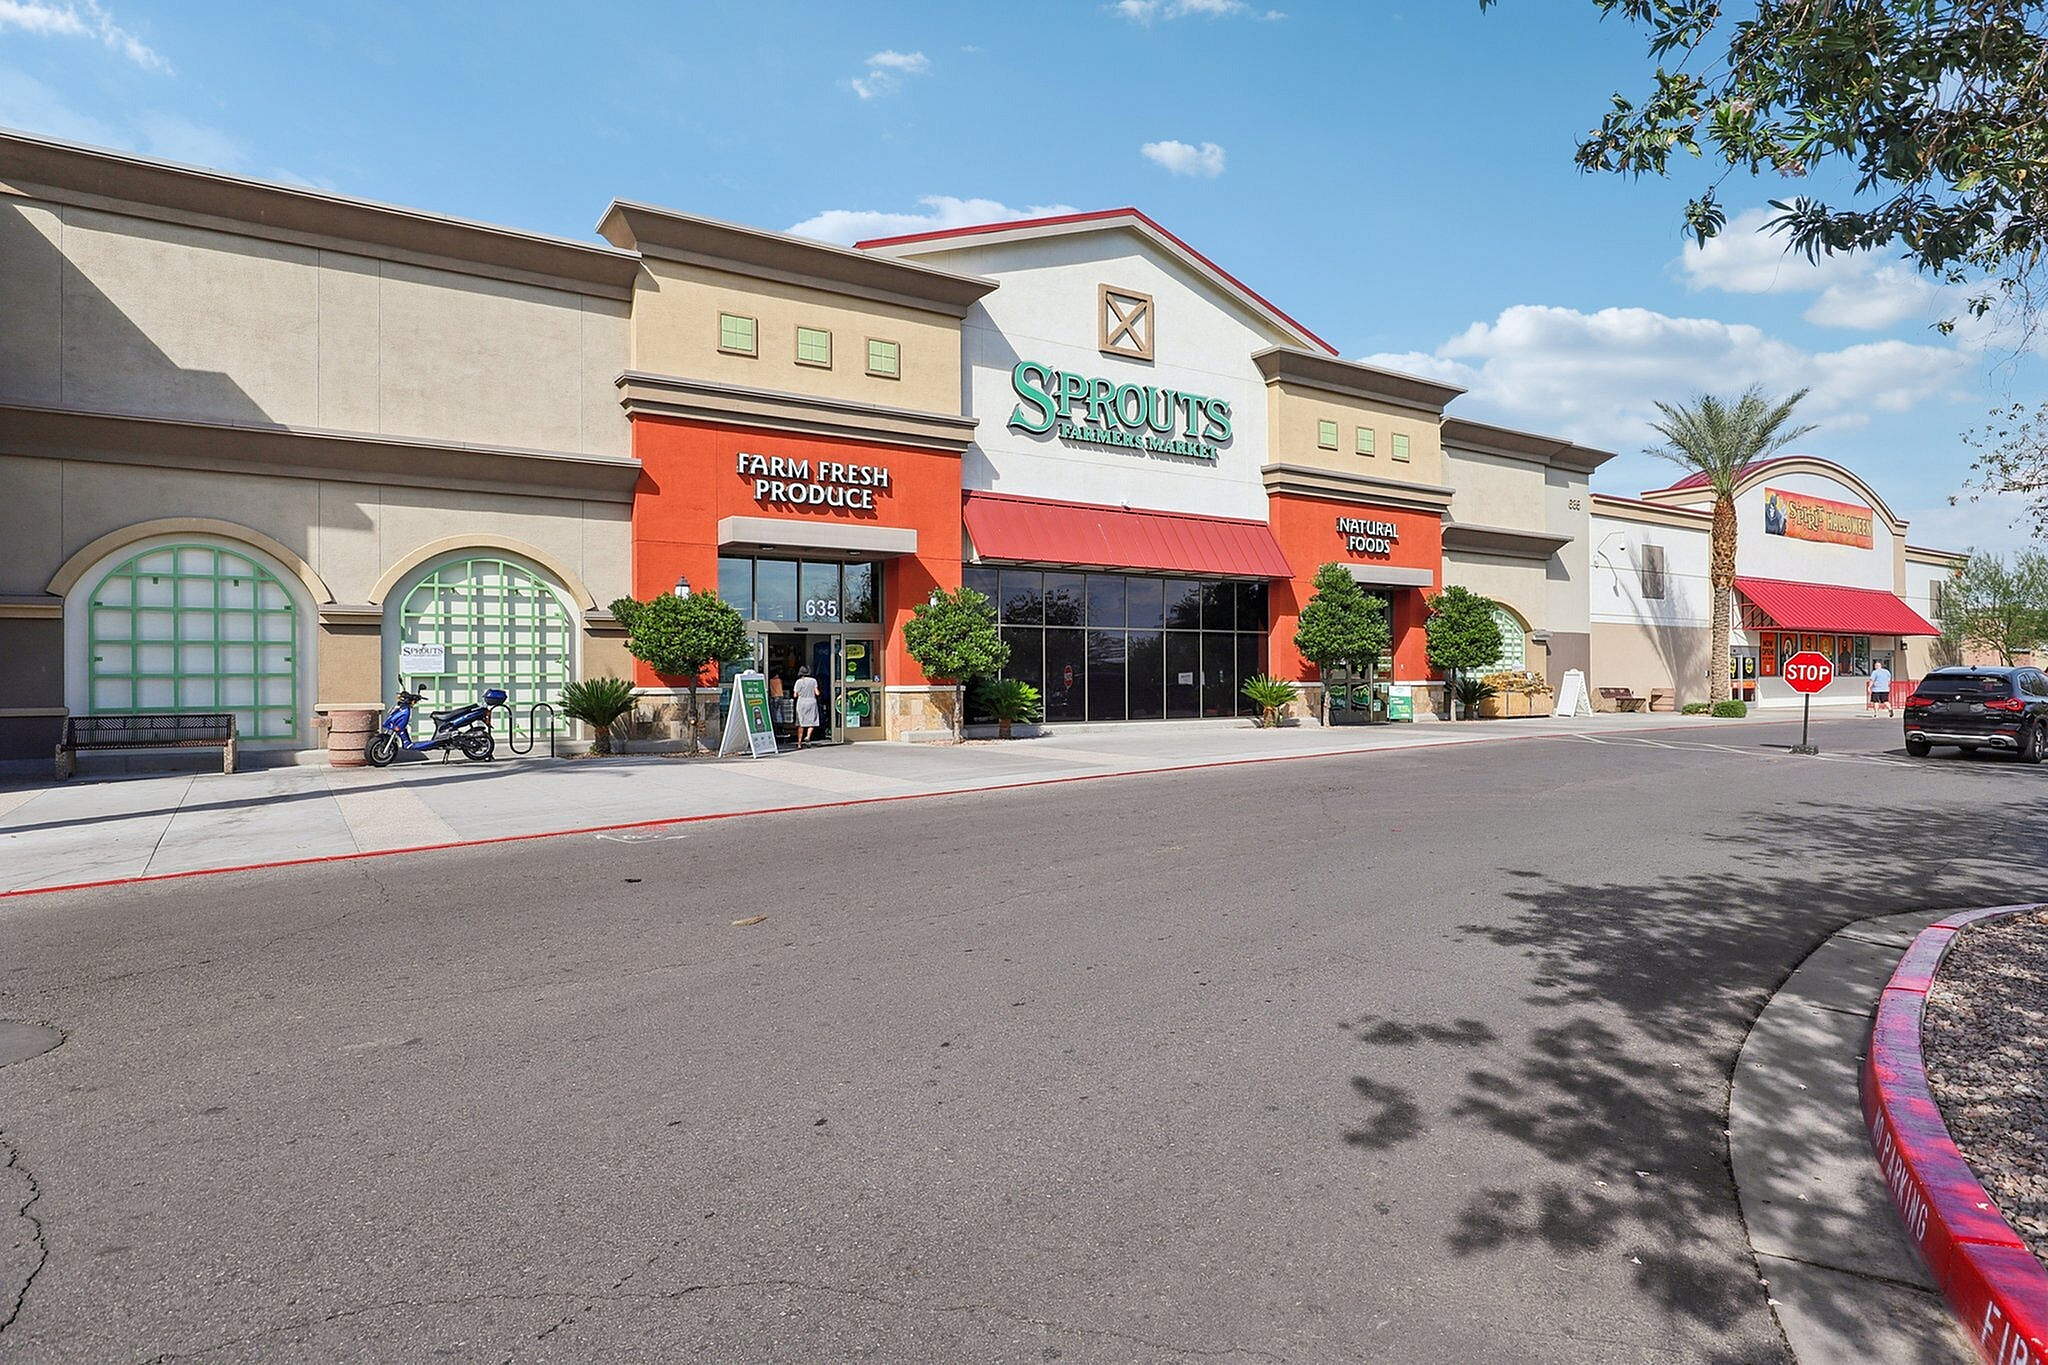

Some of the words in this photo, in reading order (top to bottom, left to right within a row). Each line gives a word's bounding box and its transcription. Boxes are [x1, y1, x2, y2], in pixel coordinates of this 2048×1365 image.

[1008, 360, 1232, 441] SPROUTS
[1060, 422, 1144, 449] FARMERS
[1146, 437, 1218, 459] MARKET
[736, 452, 809, 480] FARM
[817, 461, 889, 488] FRESH
[754, 479, 874, 510] PRODUCE
[1338, 516, 1400, 538] NATURAL
[1347, 535, 1391, 554] FOODS
[805, 599, 837, 617] 635
[403, 646, 444, 656] SPROUTS
[1787, 664, 1830, 681] STOP
[1881, 1131, 1929, 1241] PARKING
[1981, 1300, 2041, 1365] FIR
